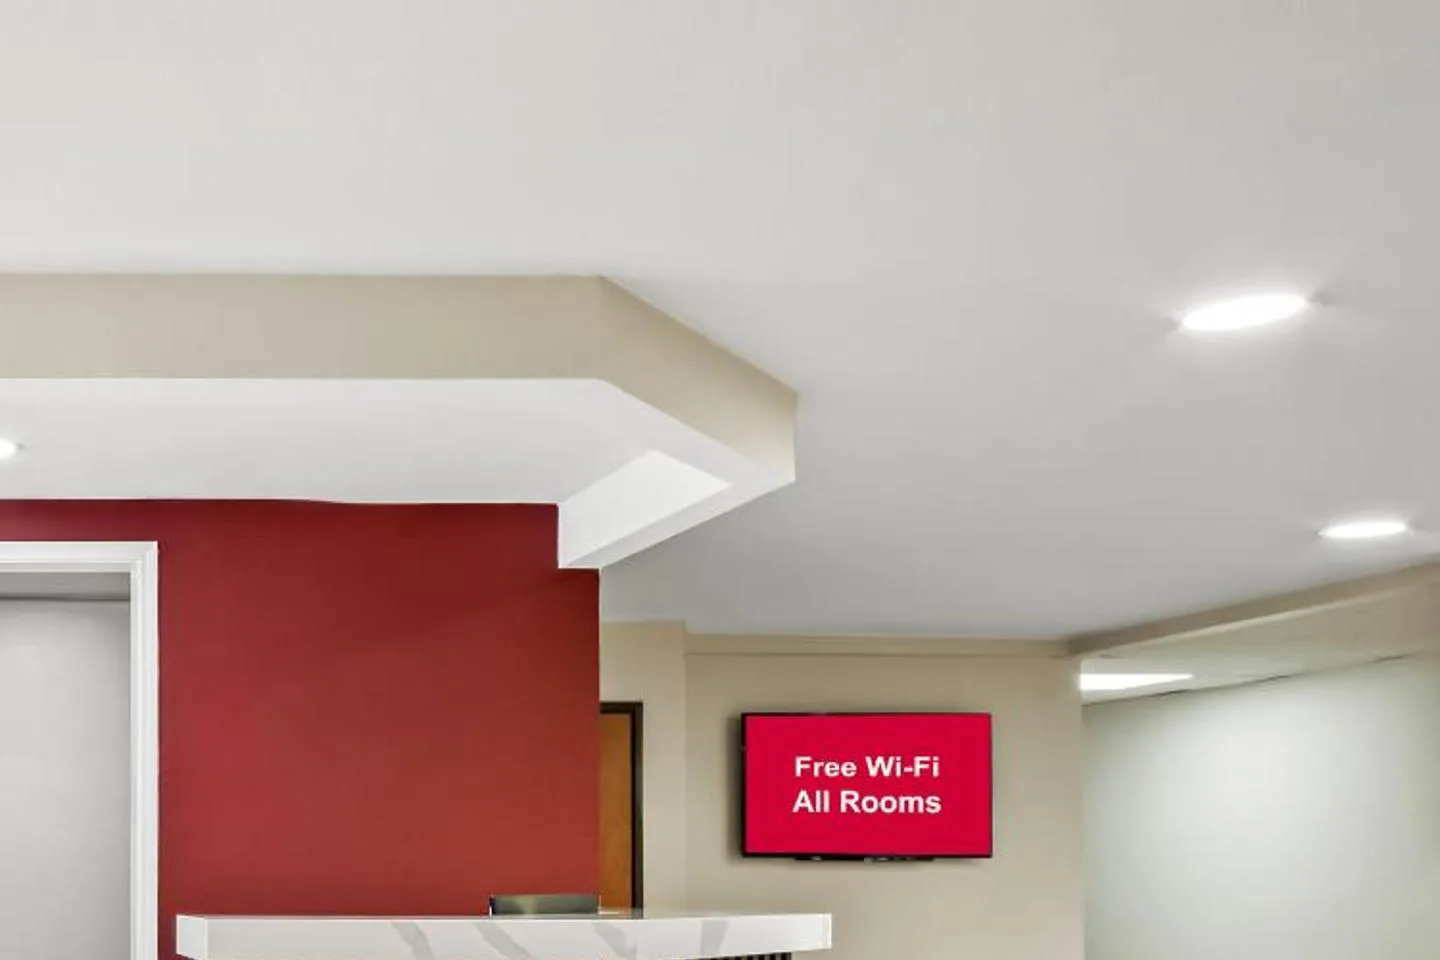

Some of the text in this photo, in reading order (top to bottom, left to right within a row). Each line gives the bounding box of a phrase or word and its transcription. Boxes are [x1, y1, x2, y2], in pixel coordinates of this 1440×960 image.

[794, 756, 940, 777] Free Wi-Fi
[792, 790, 942, 813] All Rooms
